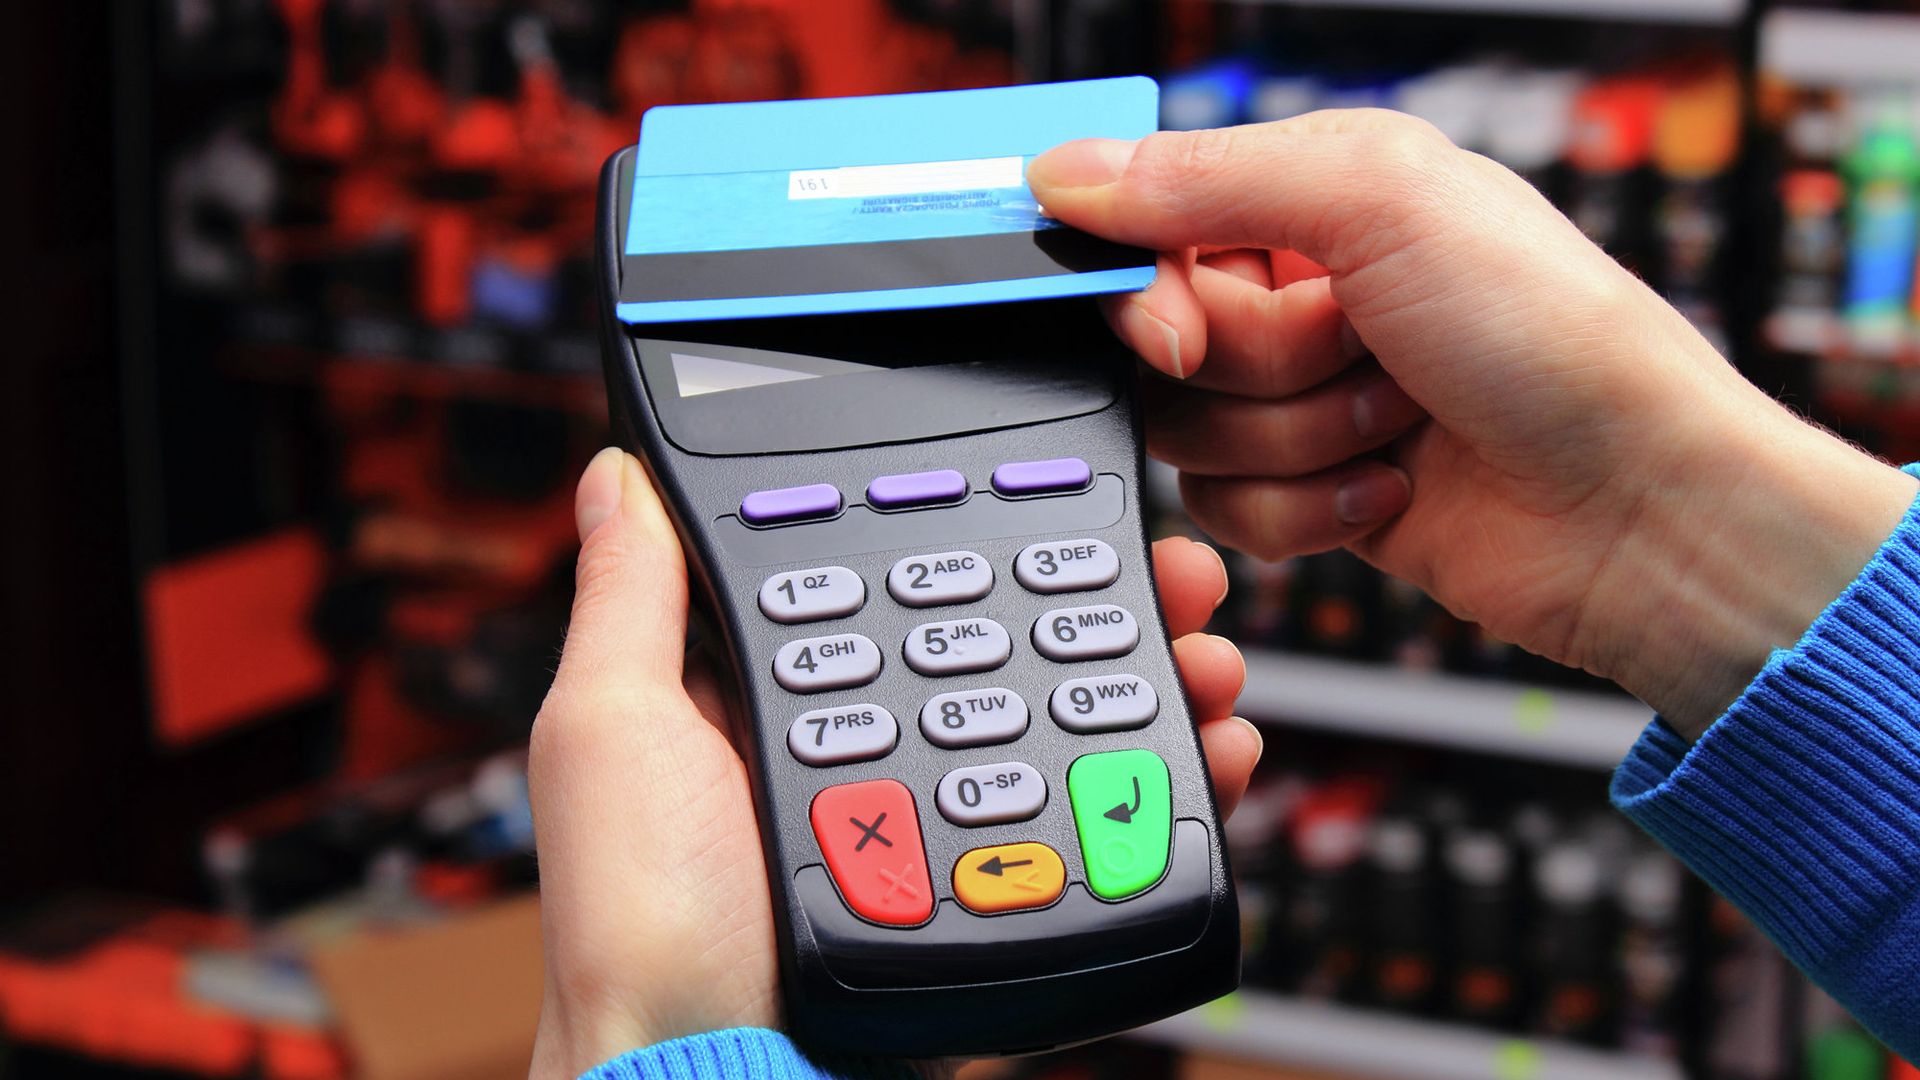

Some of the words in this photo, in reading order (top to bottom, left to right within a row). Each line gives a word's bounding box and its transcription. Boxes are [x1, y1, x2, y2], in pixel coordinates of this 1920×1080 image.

[798, 178, 828, 191] 191
[906, 562, 933, 589] 2
[933, 556, 976, 575] ABC
[1033, 549, 1060, 577] 3
[1060, 545, 1098, 562] DEF
[776, 578, 796, 605] 1
[803, 574, 830, 590] QZ
[924, 627, 949, 655] 5
[950, 624, 988, 641] JKL
[1052, 616, 1077, 643] 6
[1078, 610, 1124, 629] MNO
[792, 646, 818, 674] 4
[820, 640, 856, 659] GHI
[940, 700, 966, 729] 8
[966, 694, 1007, 713] TUV
[1069, 686, 1095, 714] 9
[1096, 681, 1139, 700] WXY
[806, 717, 829, 746] 7
[834, 711, 874, 730] PRS
